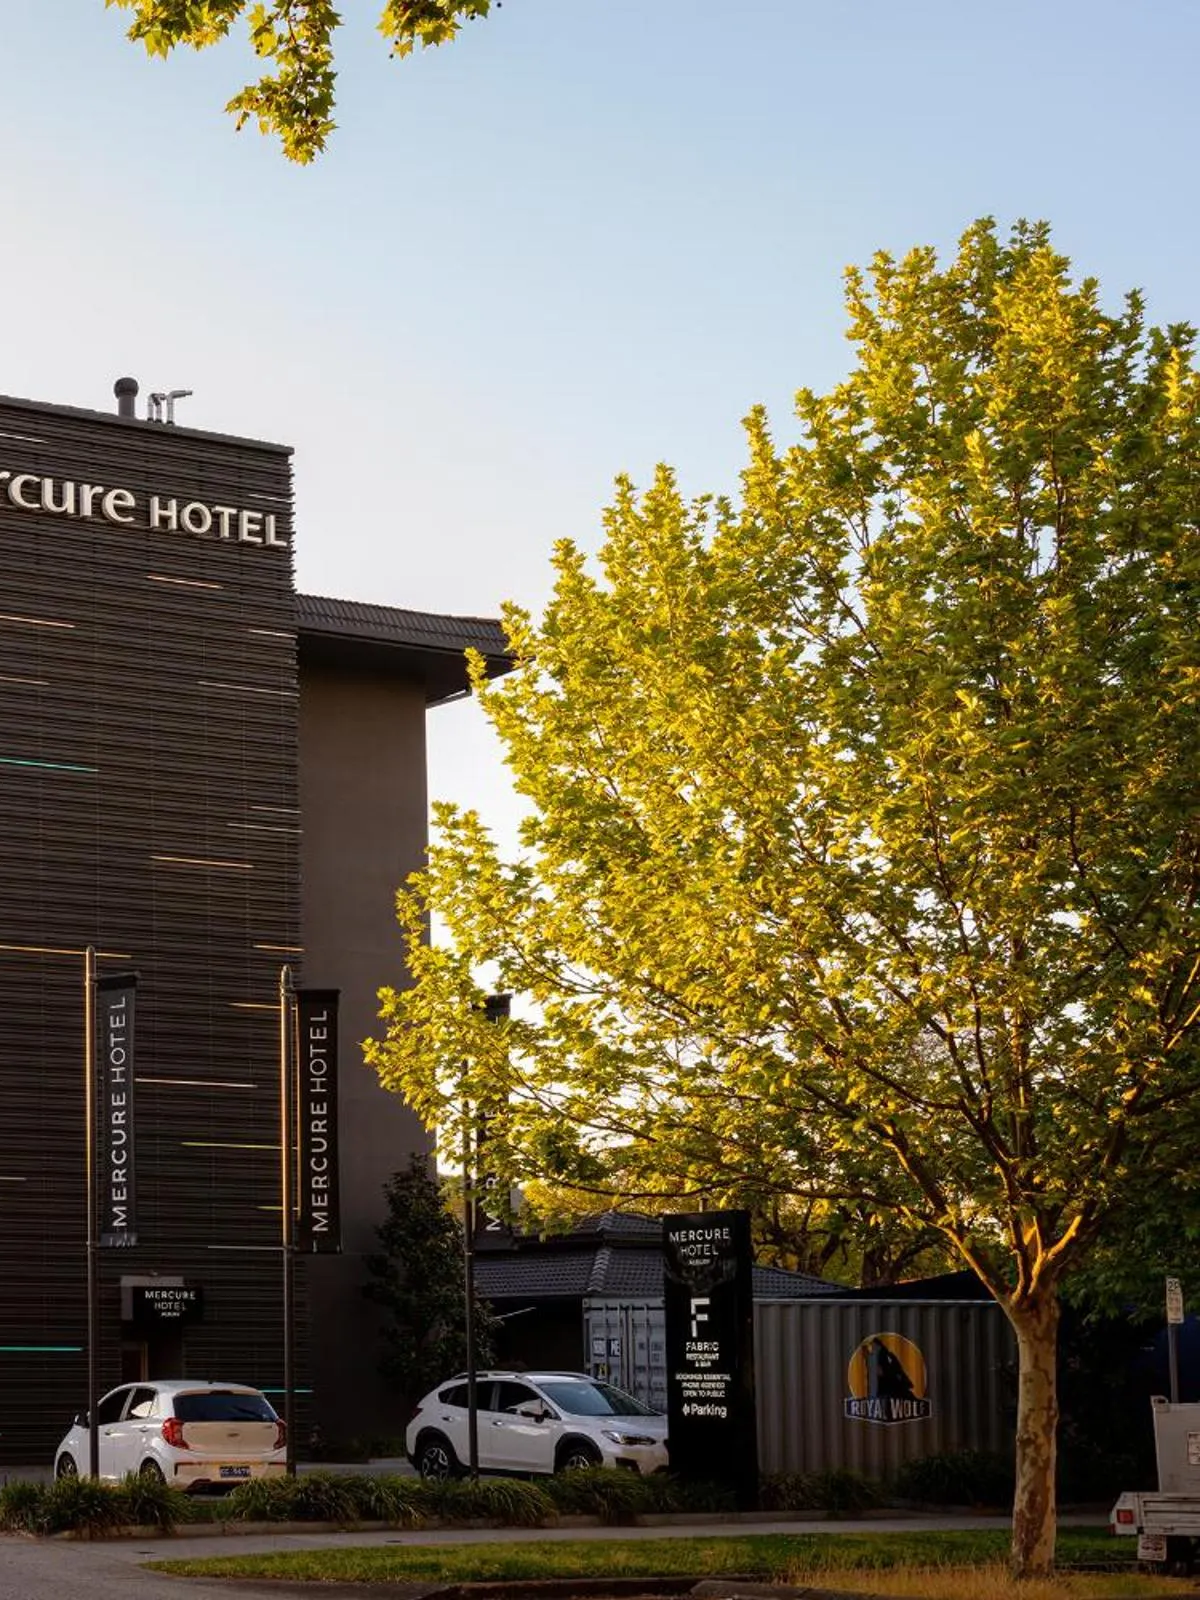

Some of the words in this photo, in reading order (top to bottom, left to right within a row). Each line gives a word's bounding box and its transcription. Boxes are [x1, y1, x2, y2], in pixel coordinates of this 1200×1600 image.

[150, 496, 287, 547] HOTEL
[110, 997, 127, 1083] HOTEL
[309, 1010, 328, 1093] HOTEL
[111, 1092, 128, 1227] MERCURE
[311, 1102, 329, 1232] MERCURE
[669, 1228, 730, 1242] MERCURE
[681, 1244, 719, 1256] HOTEL
[144, 1290, 197, 1300] MERCURE
[154, 1301, 187, 1311] HOTEL
[686, 1341, 719, 1352] FABRIC
[691, 1403, 728, 1419] Parking
[850, 1399, 887, 1420] ROYAL
[890, 1398, 926, 1419] WOLF
